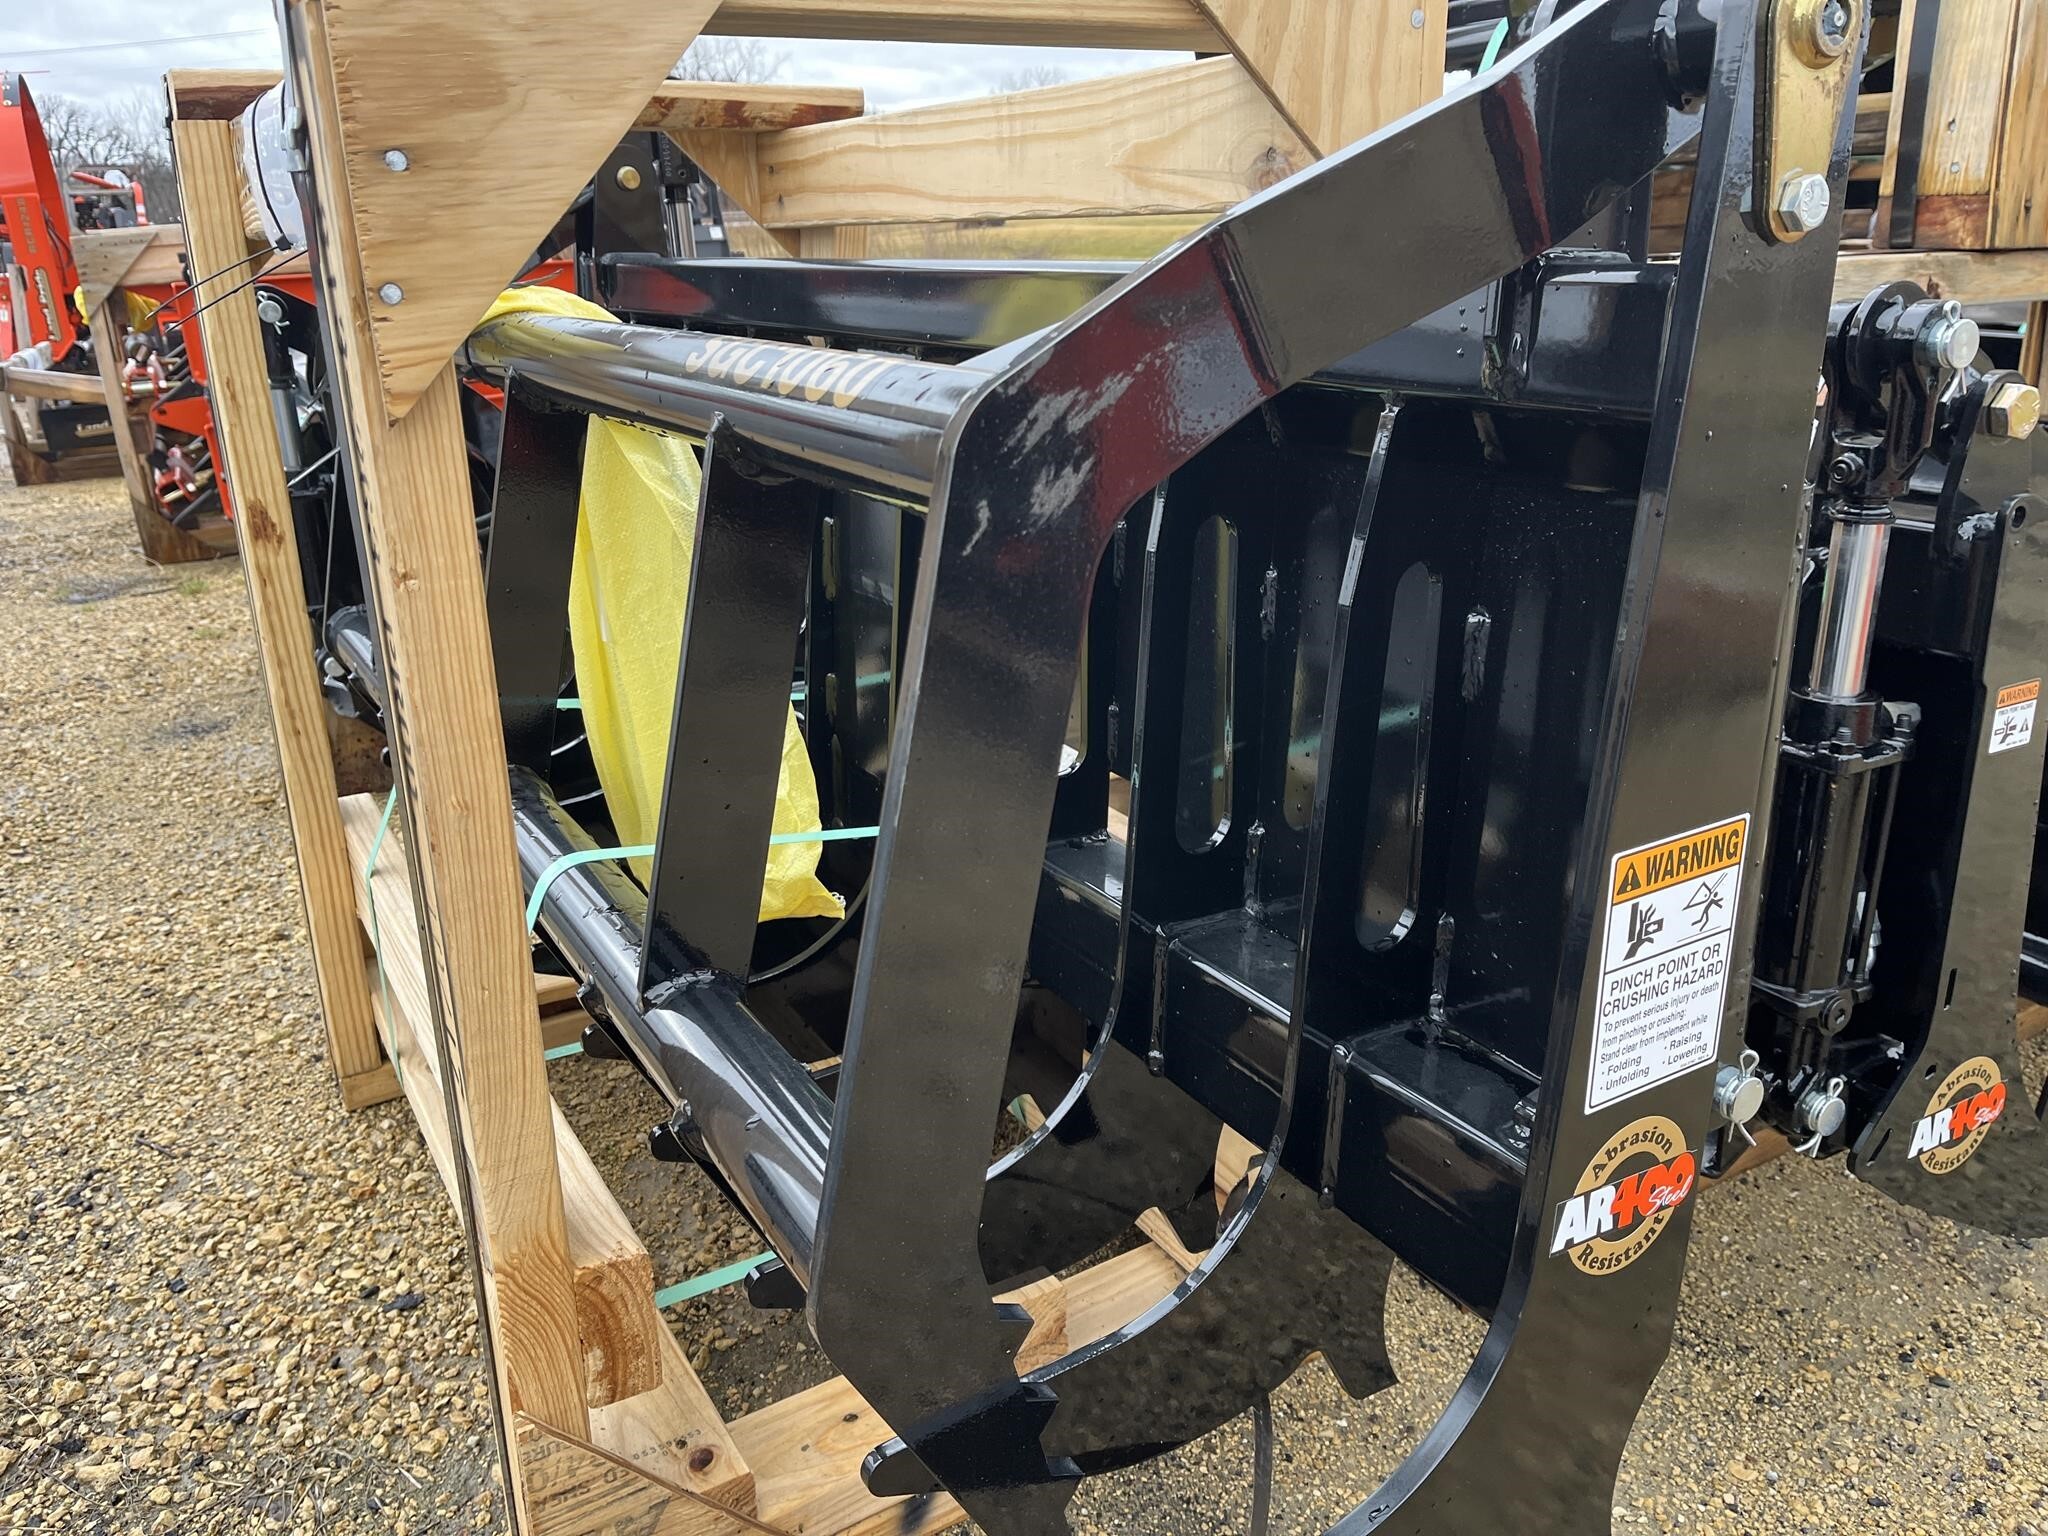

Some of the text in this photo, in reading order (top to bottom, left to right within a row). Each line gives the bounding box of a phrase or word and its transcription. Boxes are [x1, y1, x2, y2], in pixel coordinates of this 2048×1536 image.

[2005, 685, 2039, 701] WARNING
[1645, 828, 1741, 887] WARNING
[1603, 960, 1723, 1018] CRUSHING HAZARD
[1610, 942, 1722, 997] PINCH POINT OR
[1602, 1009, 1688, 1049] from pinching or crushing:
[1604, 982, 1720, 1033] To prevent serious injury or death
[1600, 1014, 1708, 1064] Stand clear from implement while
[1668, 1043, 1708, 1065] Lowering
[1669, 1031, 1702, 1051] Raising
[1605, 1066, 1650, 1091] Unfolding
[1607, 1055, 1642, 1076] Folding
[1937, 1064, 1992, 1106] Abrasion
[1907, 1082, 2008, 1159] AR400
[1592, 1126, 1674, 1182] Abrasion
[1925, 1129, 1985, 1171] Resistant
[1551, 1152, 1696, 1255] AR400
[1646, 1174, 1694, 1216] Steel
[1578, 1213, 1665, 1271] Resistant
